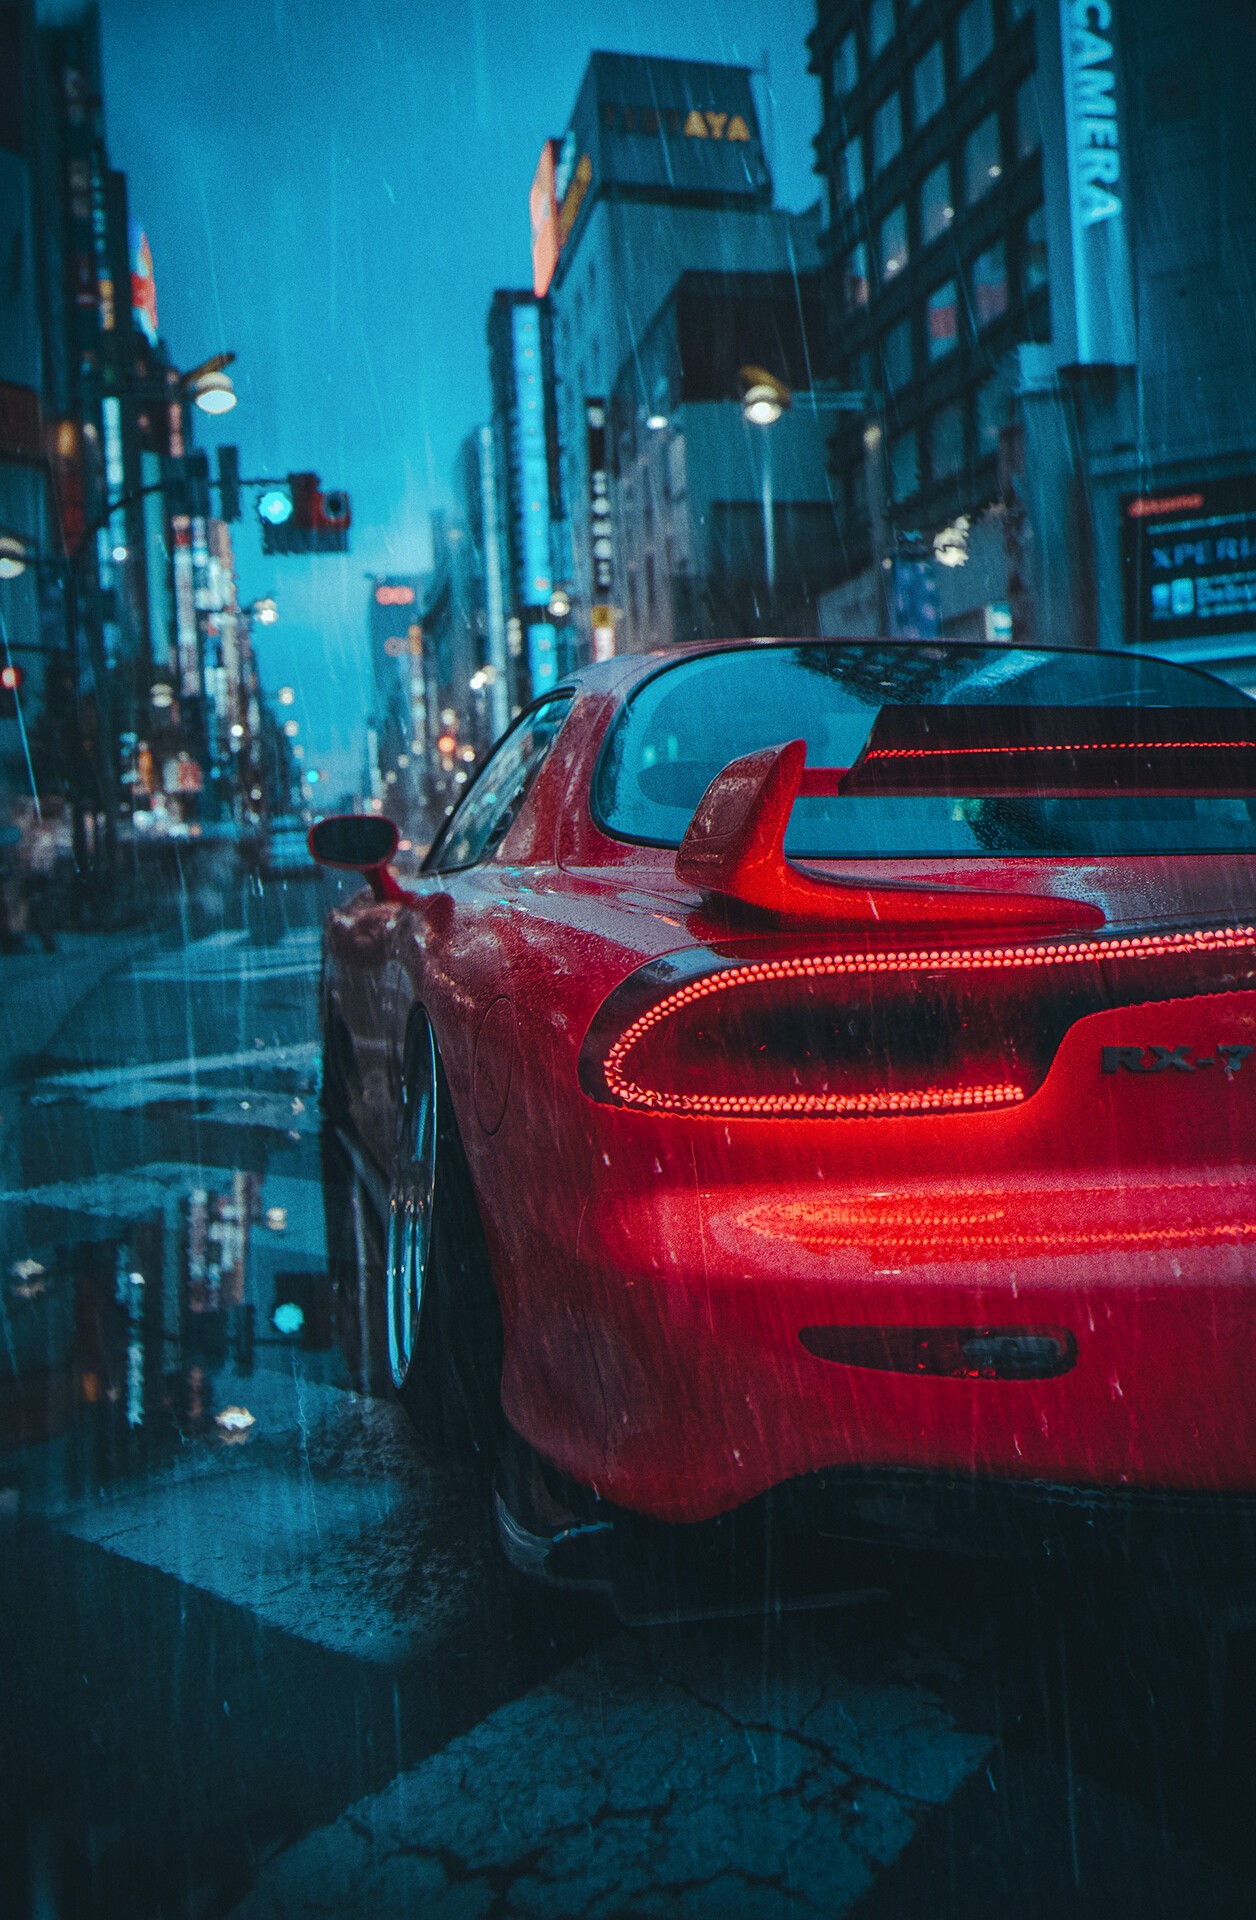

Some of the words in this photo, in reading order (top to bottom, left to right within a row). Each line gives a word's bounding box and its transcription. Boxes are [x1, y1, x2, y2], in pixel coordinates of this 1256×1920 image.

[1070, 0, 1122, 225] CAMERA
[1151, 536, 1256, 569] XPERI
[1101, 1044, 1255, 1075] RX-7
